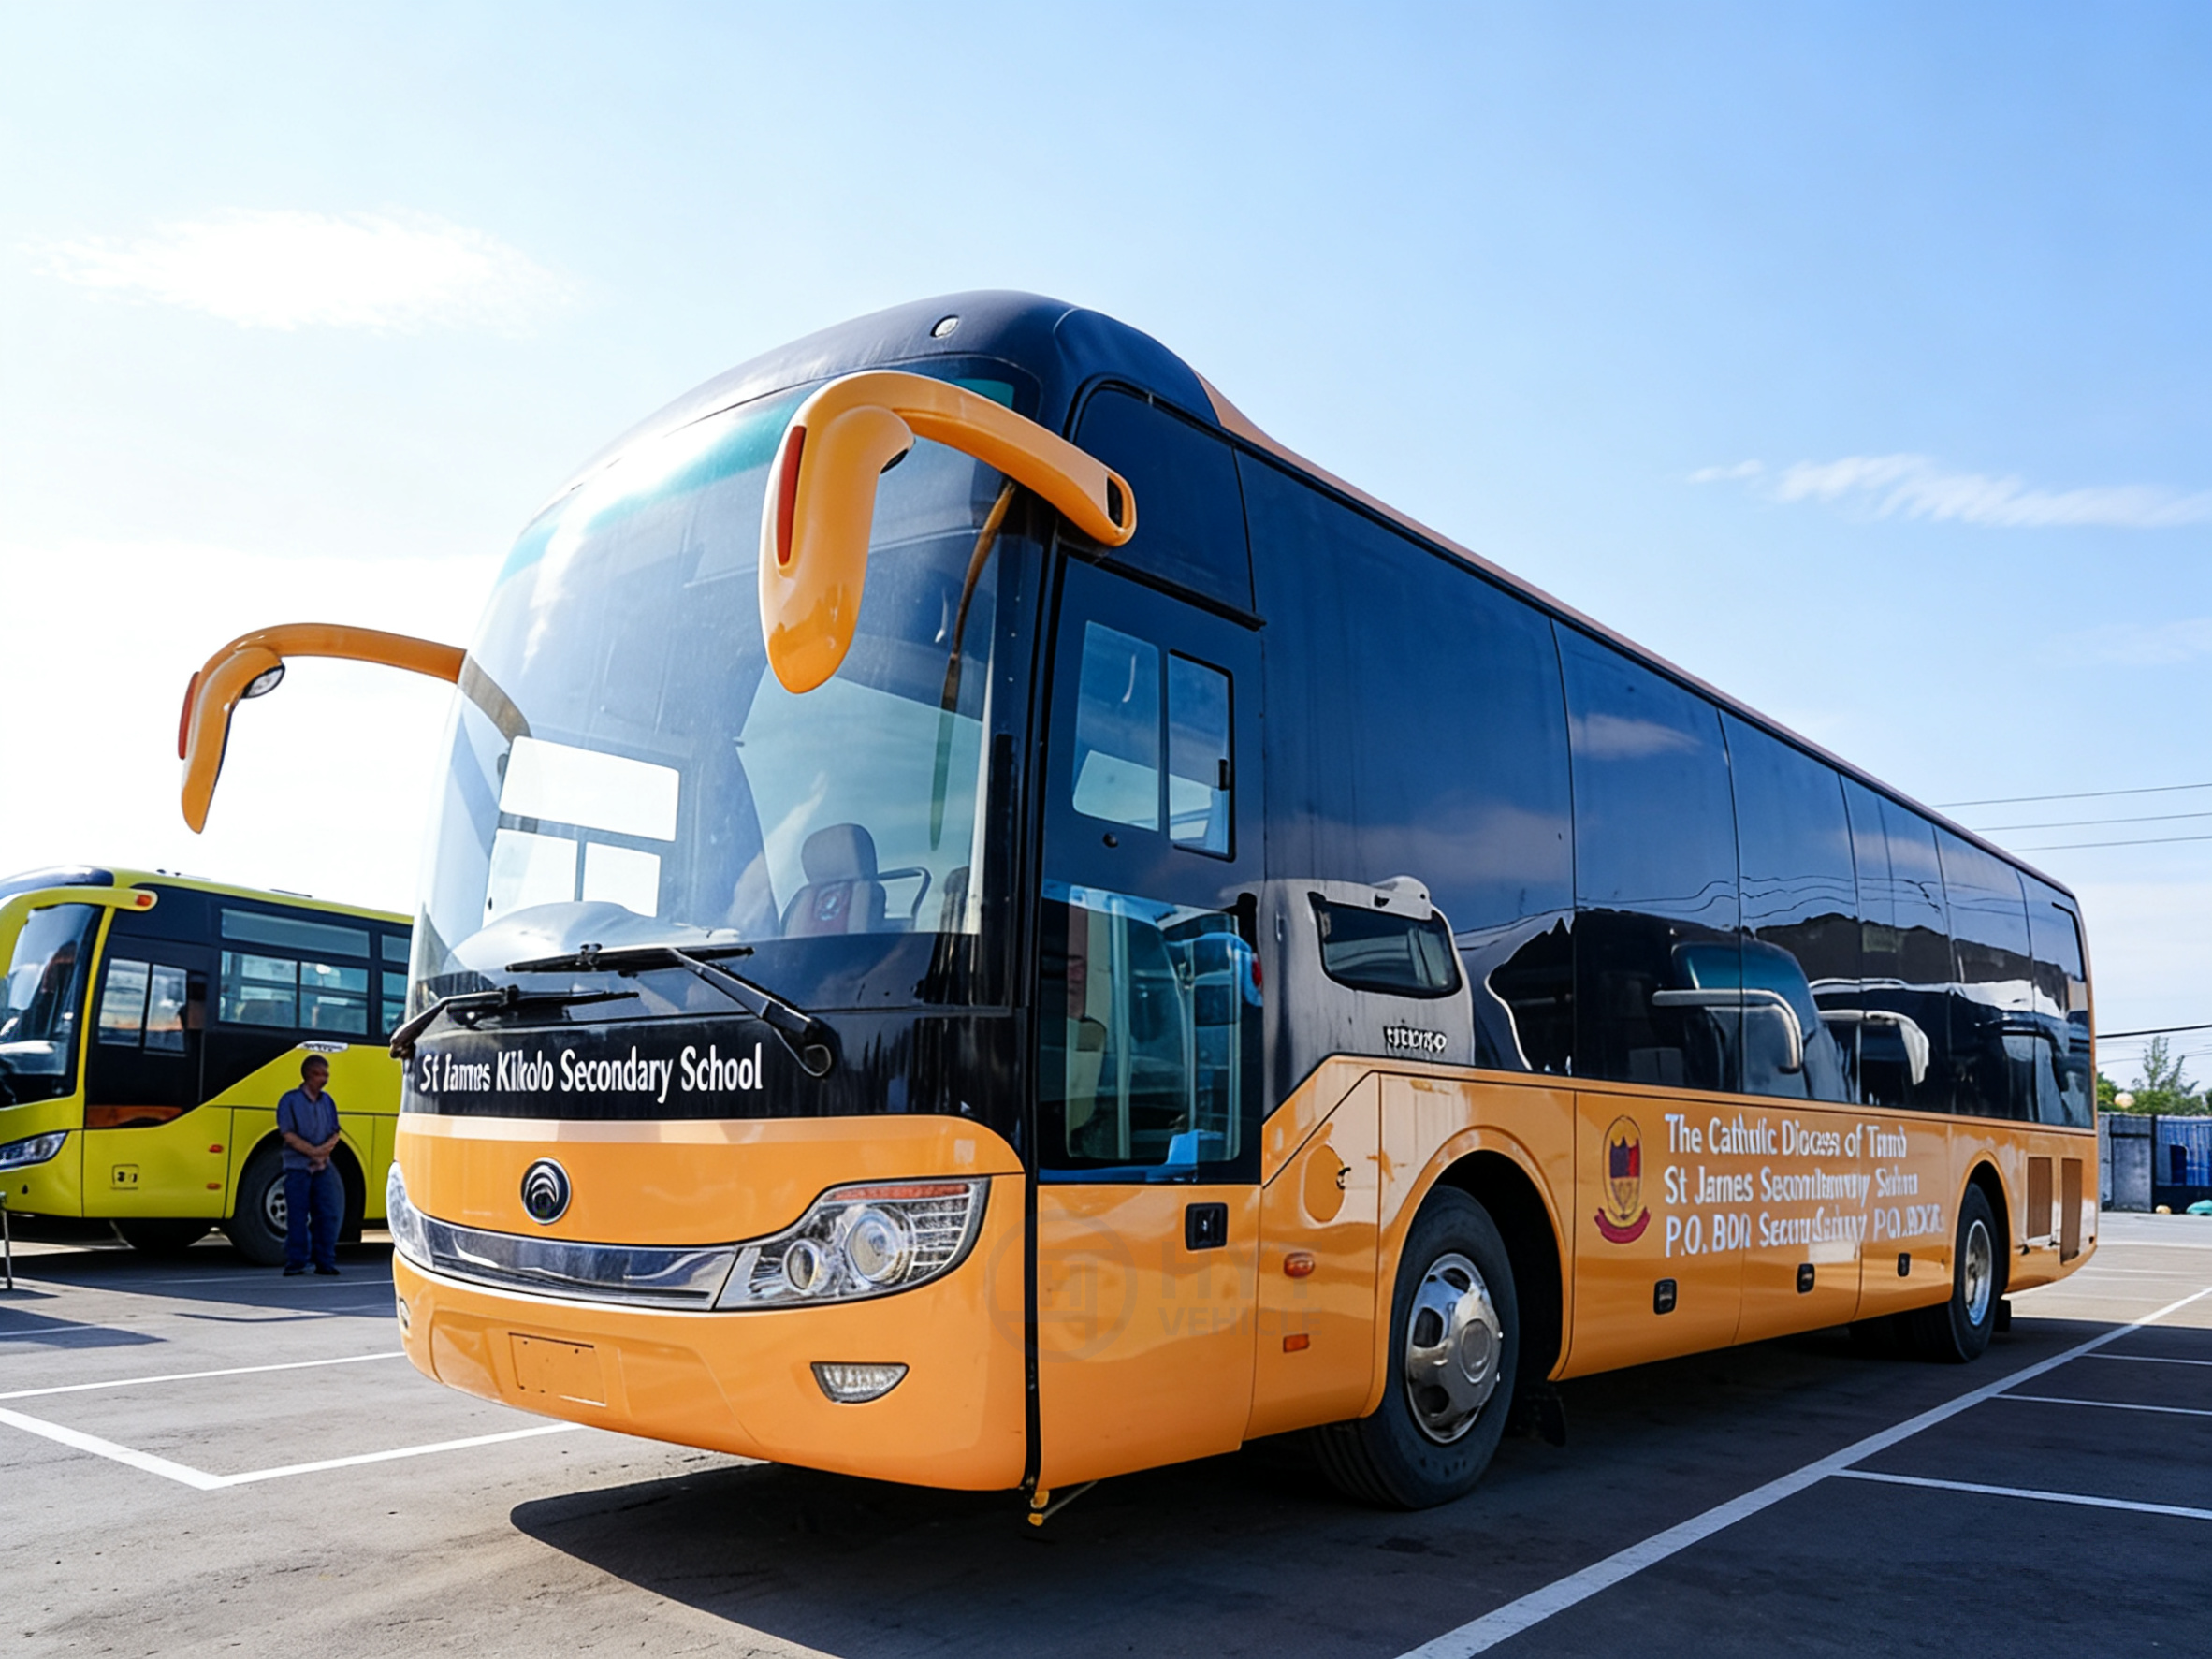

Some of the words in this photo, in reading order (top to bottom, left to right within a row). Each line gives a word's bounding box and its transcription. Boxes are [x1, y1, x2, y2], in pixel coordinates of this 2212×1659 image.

[419, 1054, 439, 1092] St
[560, 1046, 674, 1104] Secondary
[680, 1041, 764, 1093] School
[1664, 1113, 1702, 1154] The
[1844, 1122, 1863, 1158] of
[1664, 1165, 1688, 1205] St
[1694, 1165, 1754, 1205] James
